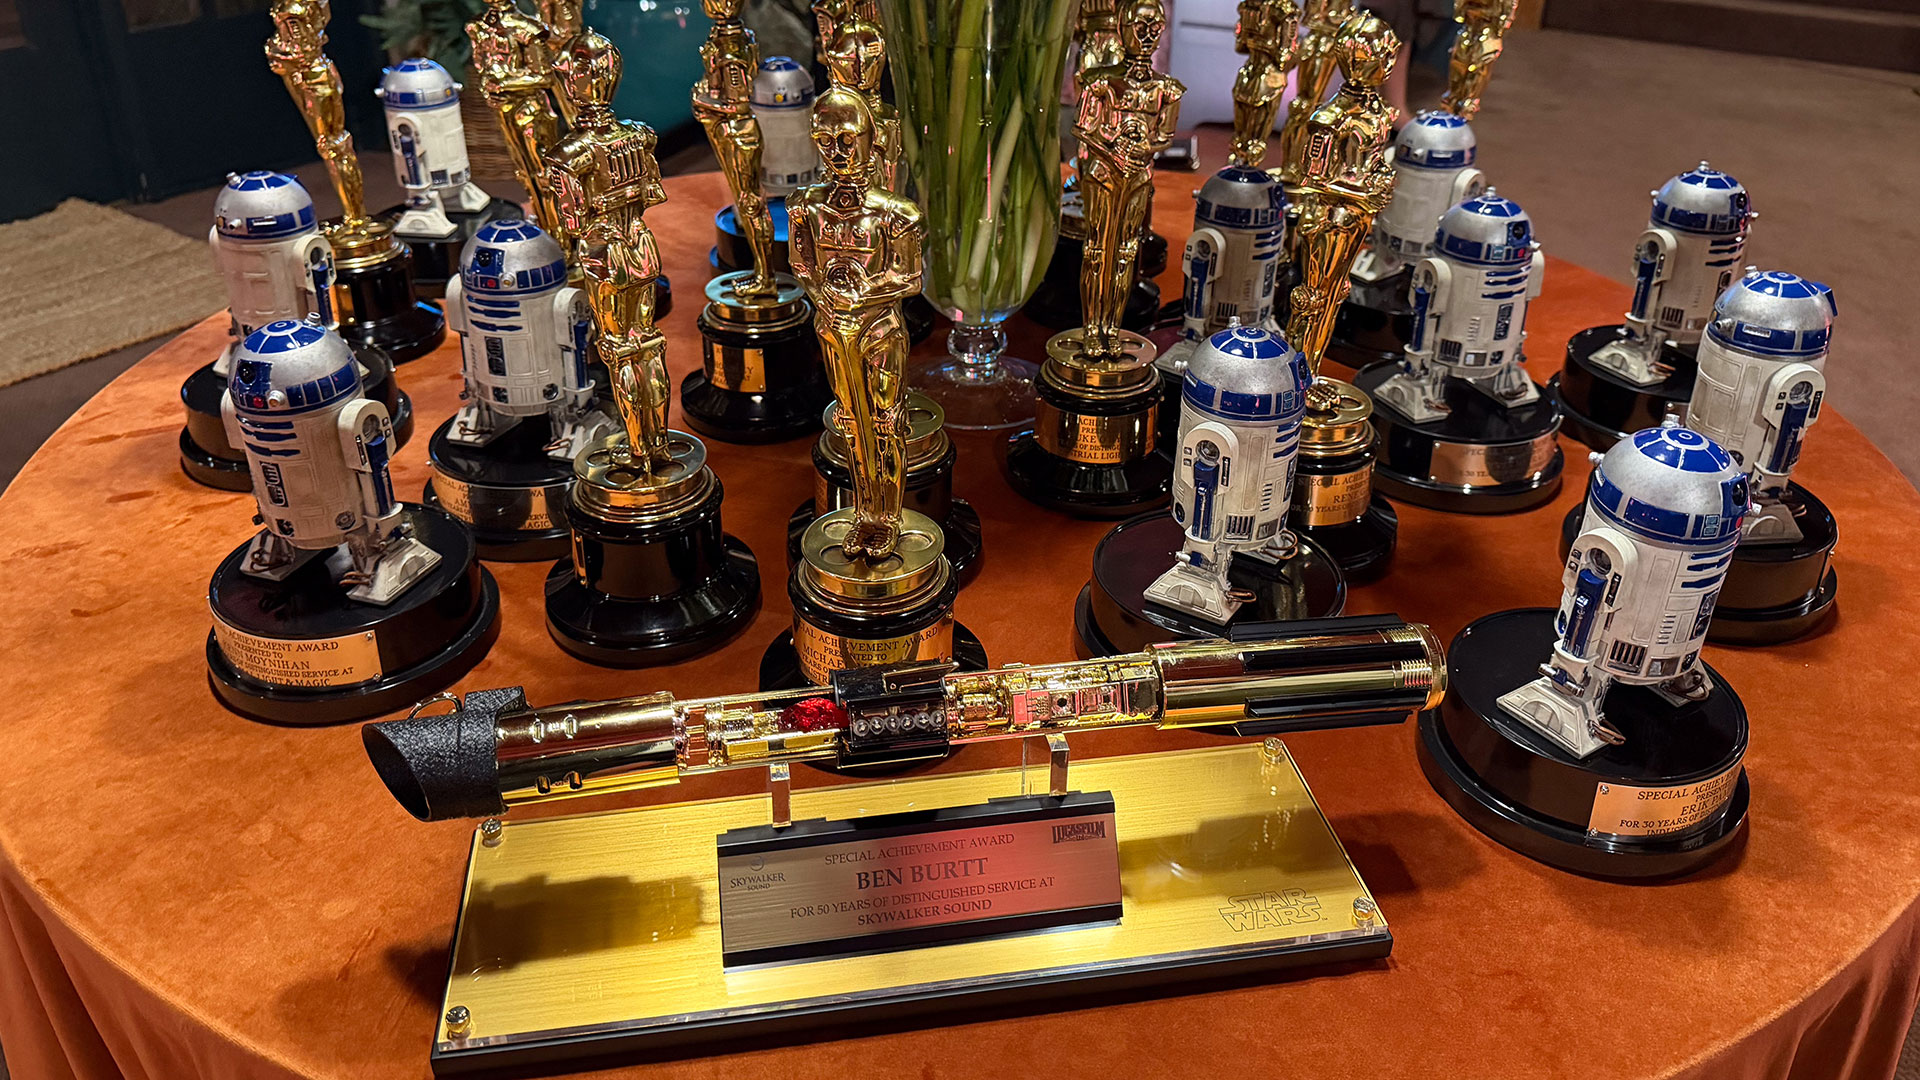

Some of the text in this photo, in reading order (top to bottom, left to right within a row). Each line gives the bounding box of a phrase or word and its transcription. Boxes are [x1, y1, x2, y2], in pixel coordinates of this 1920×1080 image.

[228, 631, 292, 652] ACHIEVEMENT
[296, 641, 339, 653] AWARD
[902, 627, 938, 648] AWARD
[245, 653, 310, 670] MOYNIHAN
[272, 651, 284, 659] TO
[301, 669, 340, 678] SERVICE
[342, 667, 354, 675] AT
[1637, 788, 1688, 800] SPECIAL
[1681, 800, 1708, 816] ERIK
[1620, 819, 1640, 828] FOR
[1657, 816, 1688, 828] YEARS
[1689, 813, 1699, 822] OF
[825, 833, 1015, 865] SPECIAL ACHIEVEMENT AWARD
[730, 872, 786, 889] SKYWALKER
[856, 857, 989, 890] BEN BURTT
[747, 883, 771, 891] SOUND
[790, 877, 1055, 919] FOR 50 YEARS OF DISTINGUISHED SERVICE AT
[1218, 887, 1319, 915] STAR
[857, 899, 992, 926] SKYWALKER SOUND
[1221, 902, 1322, 933] WARS
